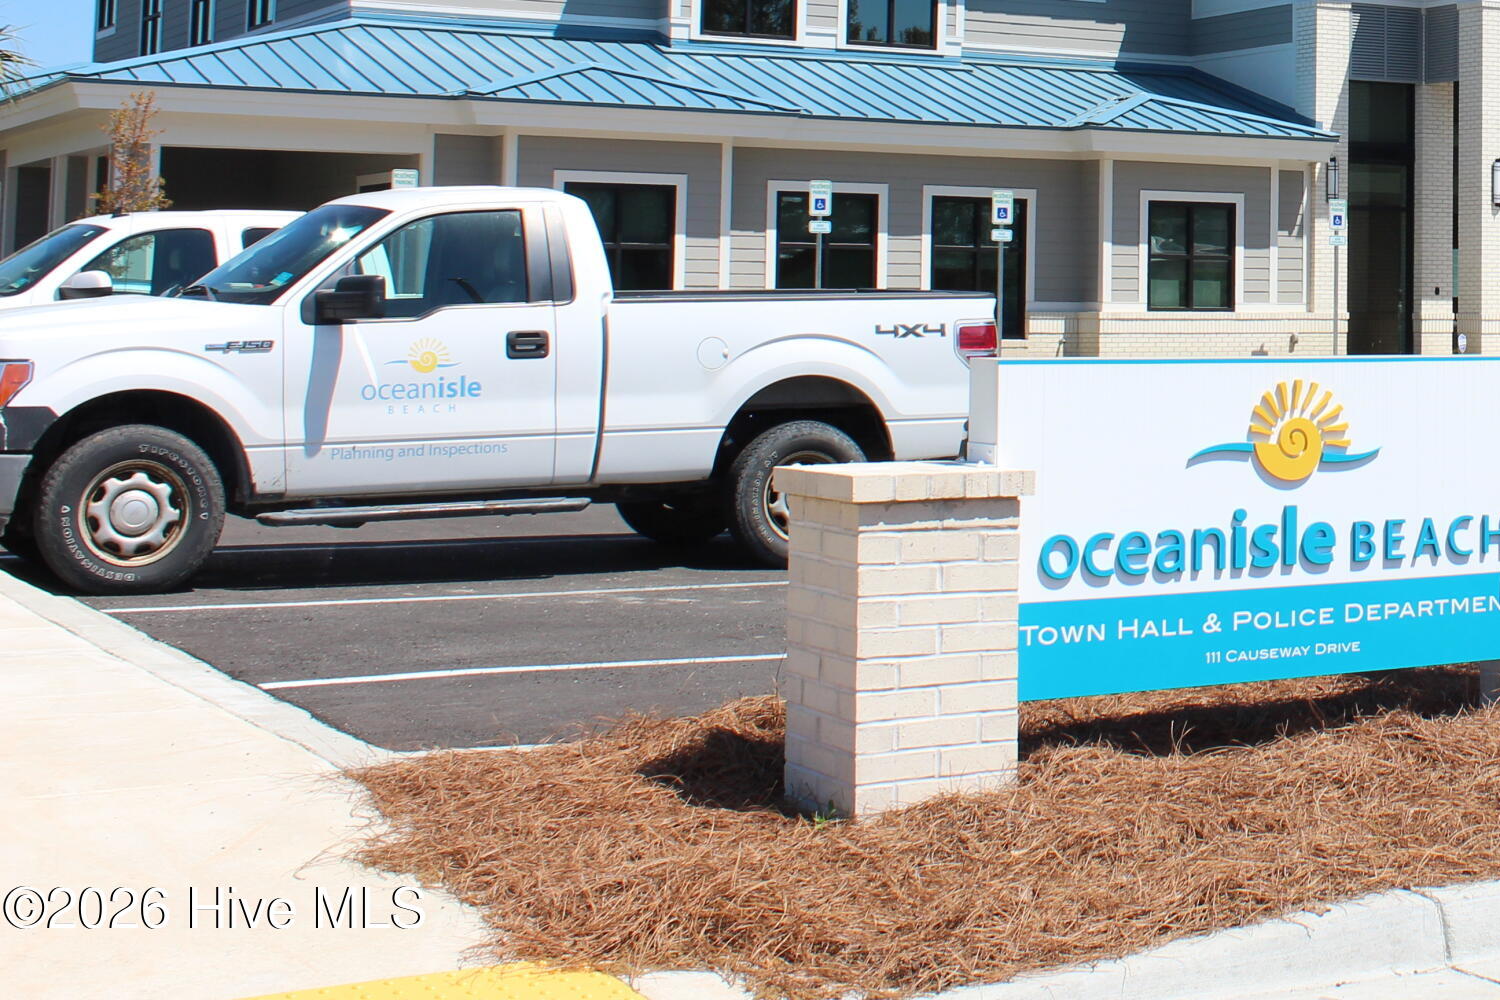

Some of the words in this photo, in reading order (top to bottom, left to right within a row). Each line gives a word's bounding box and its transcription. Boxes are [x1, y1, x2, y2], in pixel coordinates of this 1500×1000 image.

[361, 375, 481, 401] oceanisle
[387, 403, 456, 415] BEACH
[331, 446, 394, 461] Planning
[398, 444, 425, 458] and
[429, 442, 508, 458] Inspections
[60, 516, 135, 582] DESTINATION
[1039, 504, 1336, 581] oceanisle
[1019, 623, 1105, 646] TOWN
[1117, 617, 1193, 640] HALL
[1202, 612, 1222, 634] &
[1233, 607, 1334, 631] POLICE
[1205, 651, 1221, 664] 111
[1225, 645, 1311, 663] CAUSEWAY
[1314, 641, 1361, 655] DRIVE
